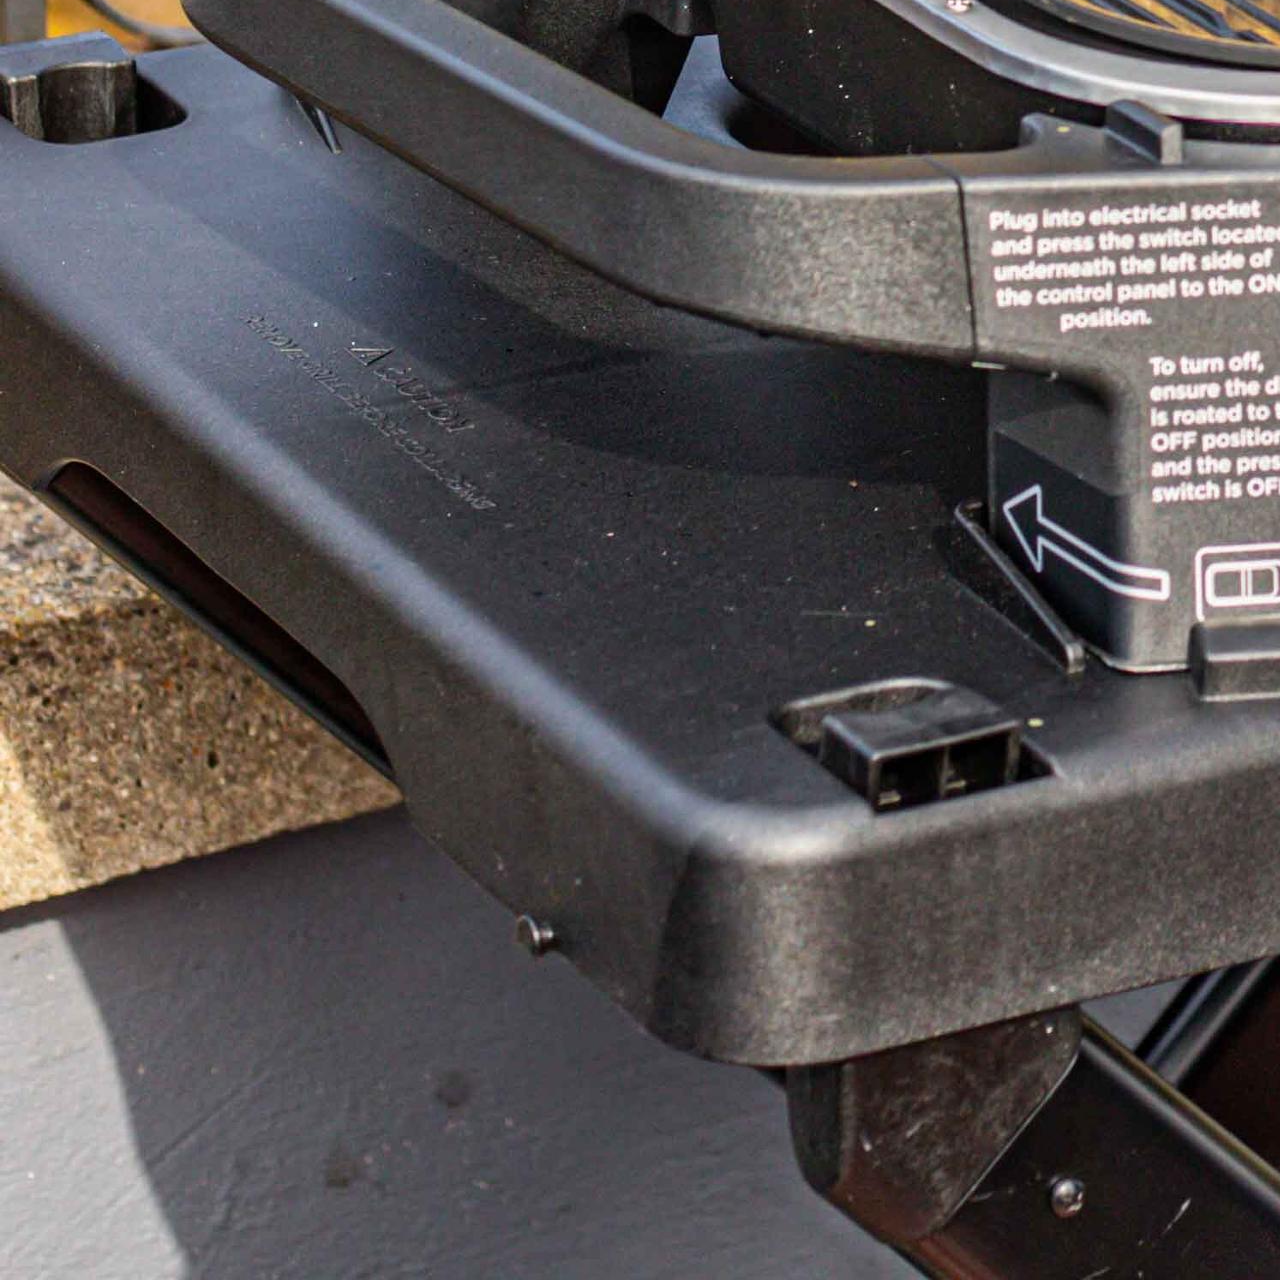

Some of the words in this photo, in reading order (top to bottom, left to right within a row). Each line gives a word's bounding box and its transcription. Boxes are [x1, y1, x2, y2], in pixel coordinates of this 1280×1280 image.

[988, 210, 1038, 232] Plug
[1042, 208, 1086, 228] into
[1088, 201, 1187, 224] electrical
[1190, 198, 1262, 221] socket
[990, 234, 1033, 256] and
[1036, 234, 1095, 255] press
[1098, 230, 1135, 251] the
[1138, 226, 1208, 249] switch
[993, 258, 1117, 281] underneath
[1119, 255, 1157, 276] the
[1160, 251, 1197, 273] left
[1200, 249, 1246, 271] side
[1249, 247, 1274, 269] of
[995, 286, 1033, 308] the
[1035, 282, 1113, 304] control
[1116, 278, 1177, 303] panel
[1179, 278, 1205, 298] to
[1207, 275, 1245, 297] the
[1060, 306, 1153, 333] position.
[1148, 355, 1177, 376] To
[1179, 355, 1225, 375] turn
[1228, 350, 1265, 373] off,
[1149, 381, 1222, 402] ensure
[1224, 377, 1261, 398] the
[1150, 407, 1169, 427] is
[1172, 403, 1243, 426] roated
[1246, 402, 1271, 422] to
[1150, 430, 1198, 453] OFF
[1151, 455, 1193, 478] and
[1195, 454, 1232, 475] the
[1151, 480, 1221, 504] switch
[1224, 477, 1243, 499] is
